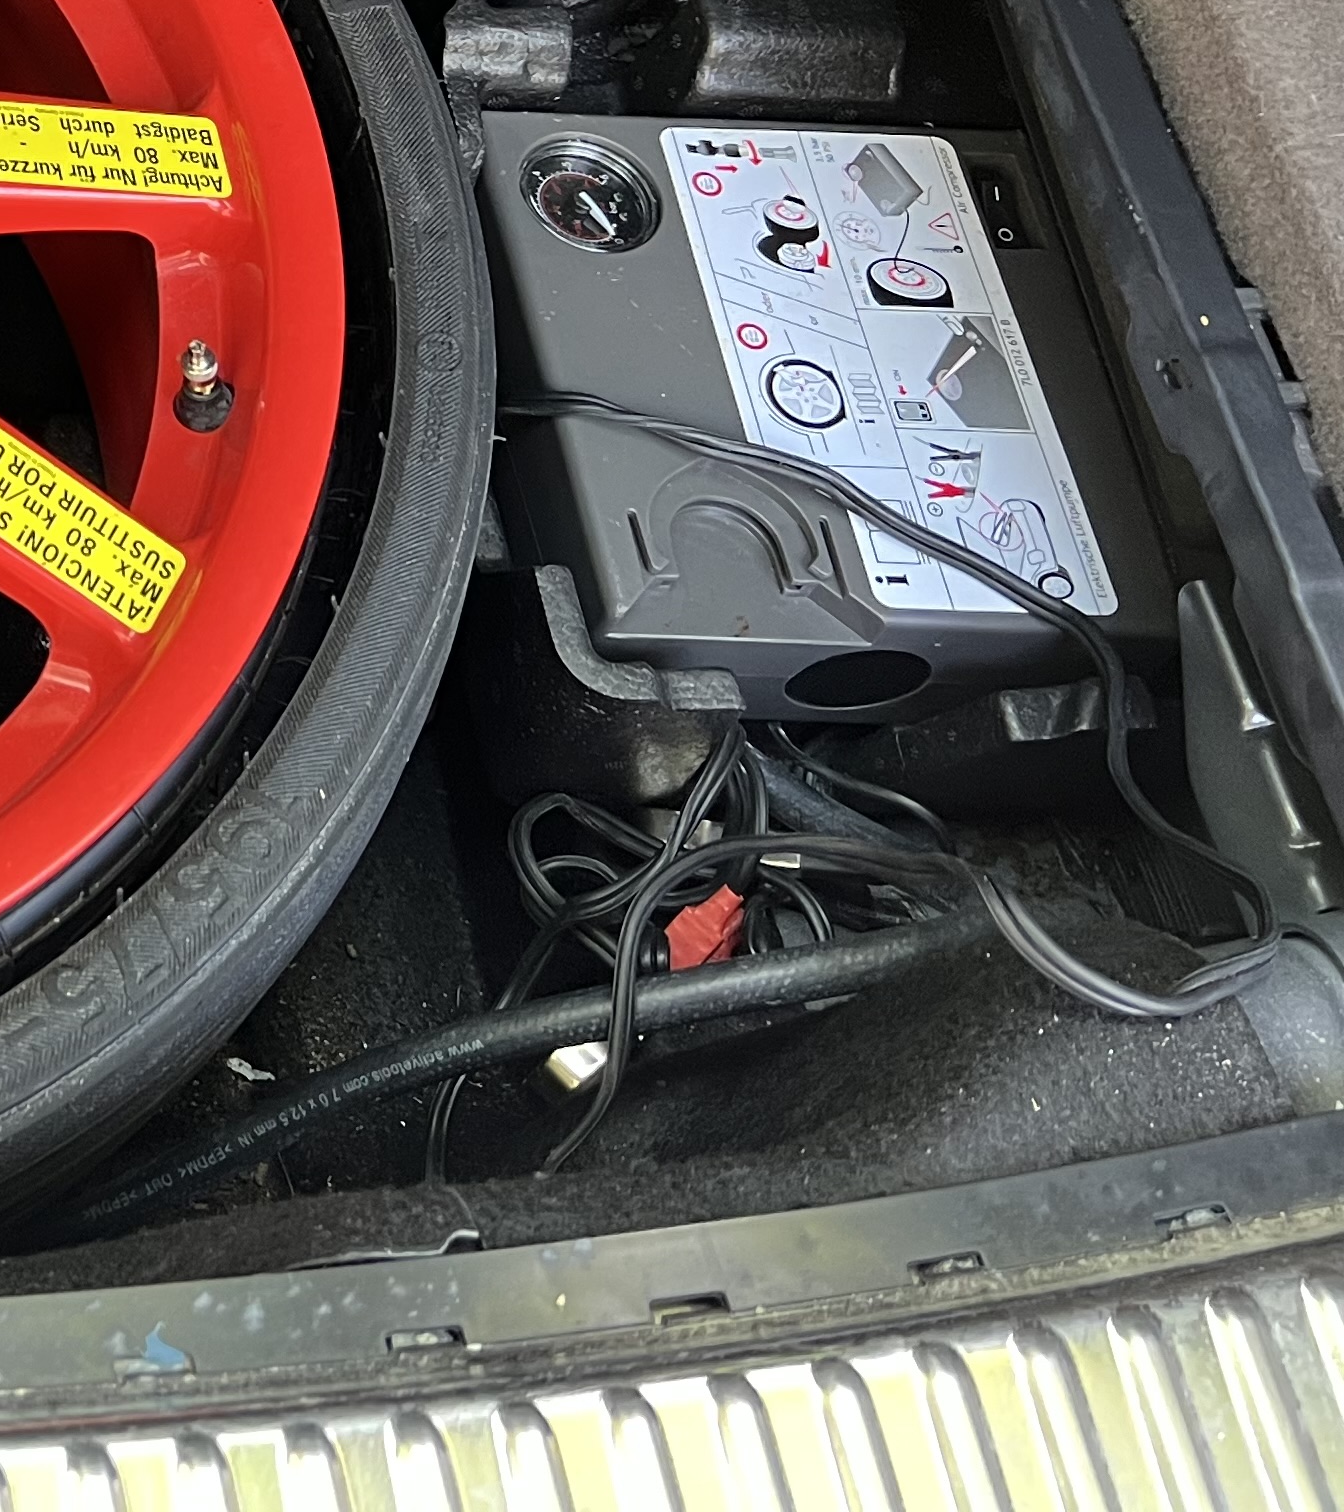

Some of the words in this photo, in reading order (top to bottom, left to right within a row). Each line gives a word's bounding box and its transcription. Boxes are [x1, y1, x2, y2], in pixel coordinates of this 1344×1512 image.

[57, 115, 117, 139] durch
[131, 121, 213, 146] Baldigst
[65, 136, 122, 162] km/h
[131, 145, 161, 164] 80
[169, 147, 220, 169] Max.
[66, 162, 97, 184] für
[99, 165, 138, 186] Nur
[138, 164, 226, 192] Achtung!
[935, 144, 966, 197] Compressor
[755, 289, 779, 314] oder
[1002, 327, 1020, 346] 617
[1009, 347, 1027, 366] 012
[2, 452, 58, 500] POR
[1054, 478, 1090, 536] Luftpumpe
[53, 487, 179, 582] SUSTITUIR
[62, 523, 98, 558] 80
[11, 520, 155, 632] ¡ATENCIÓN!
[103, 551, 166, 604] Máx.
[1076, 538, 1110, 599] Elektrische
[140, 1170, 175, 1197] OUT
